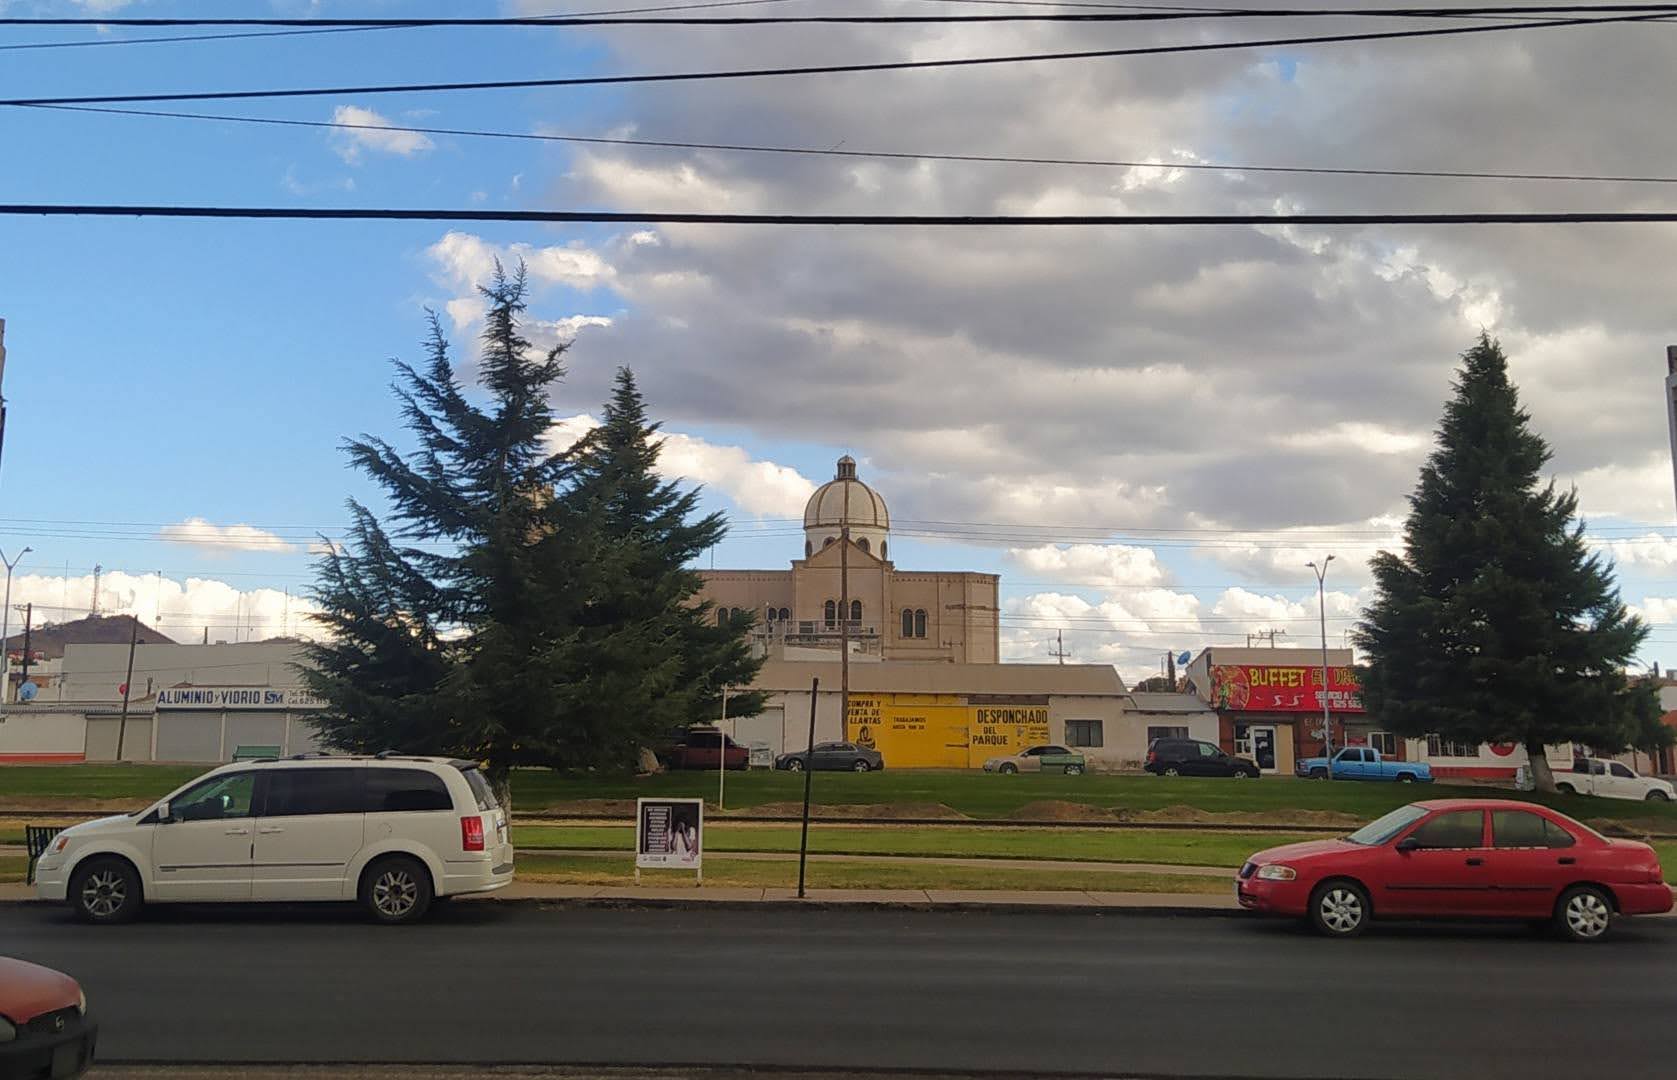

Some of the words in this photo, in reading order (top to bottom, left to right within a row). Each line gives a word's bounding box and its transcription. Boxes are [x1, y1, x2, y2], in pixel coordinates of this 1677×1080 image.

[1249, 668, 1306, 687] BUFFET
[158, 690, 214, 704] ALUMINIO
[221, 690, 260, 704] VIDRIO
[977, 709, 1047, 723] DESPONCHADO
[983, 726, 997, 735] DEL
[972, 735, 1008, 745] PARQUE
